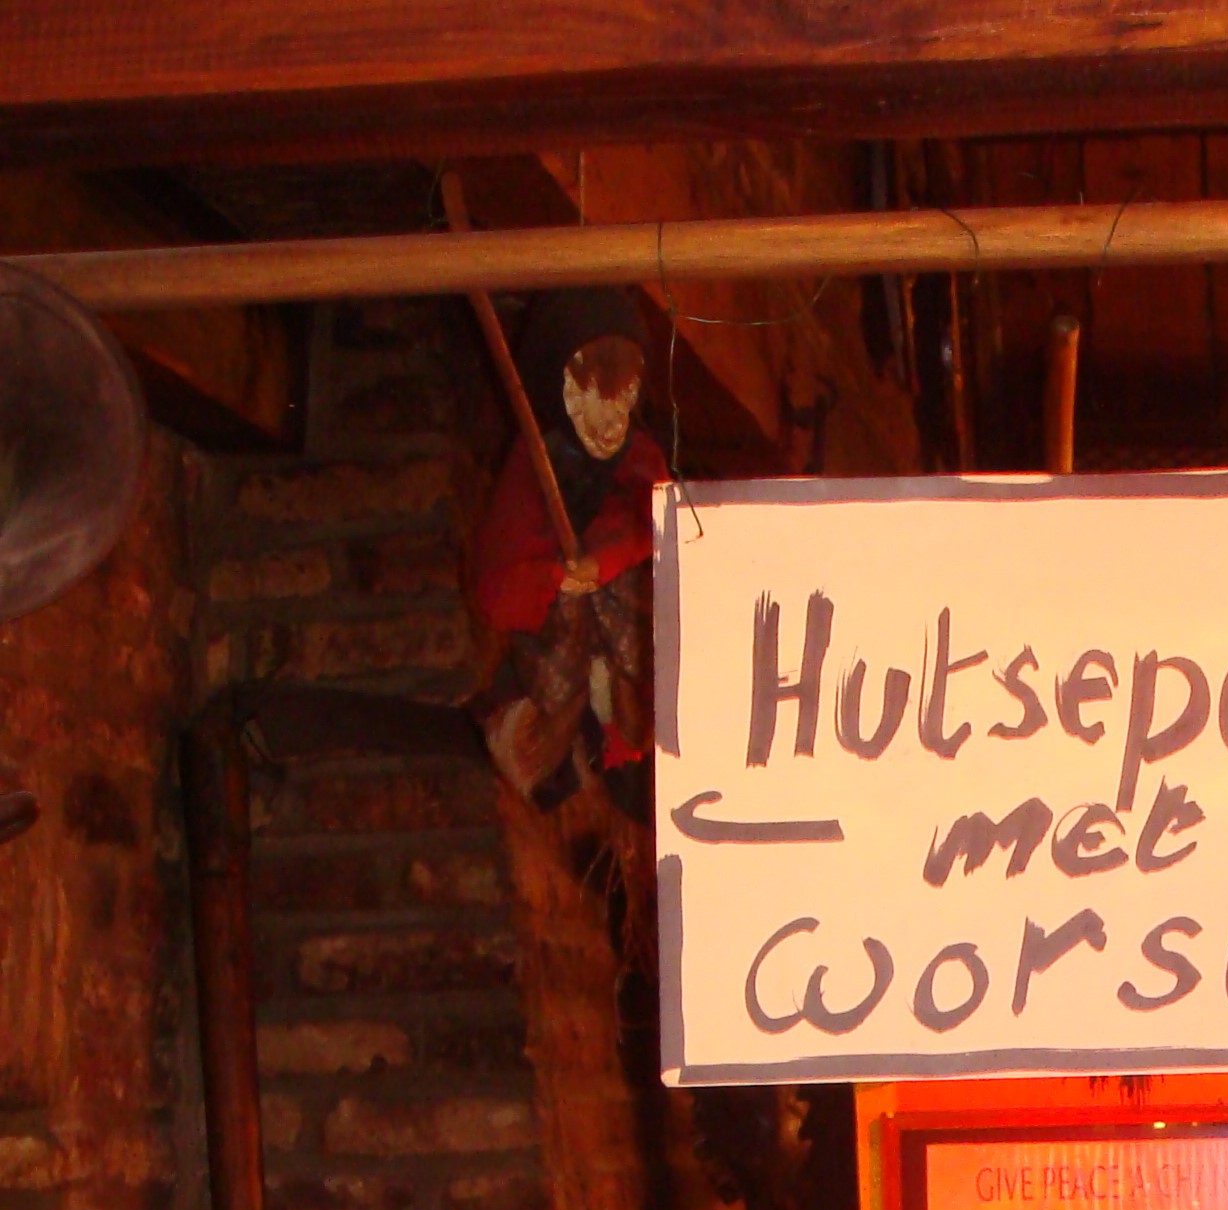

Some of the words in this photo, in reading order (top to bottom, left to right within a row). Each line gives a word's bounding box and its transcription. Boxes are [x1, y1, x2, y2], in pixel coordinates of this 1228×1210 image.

[922, 775, 1205, 887] met
[975, 1166, 1034, 1201] GIVE
[1043, 1164, 1120, 1200] PEACE
